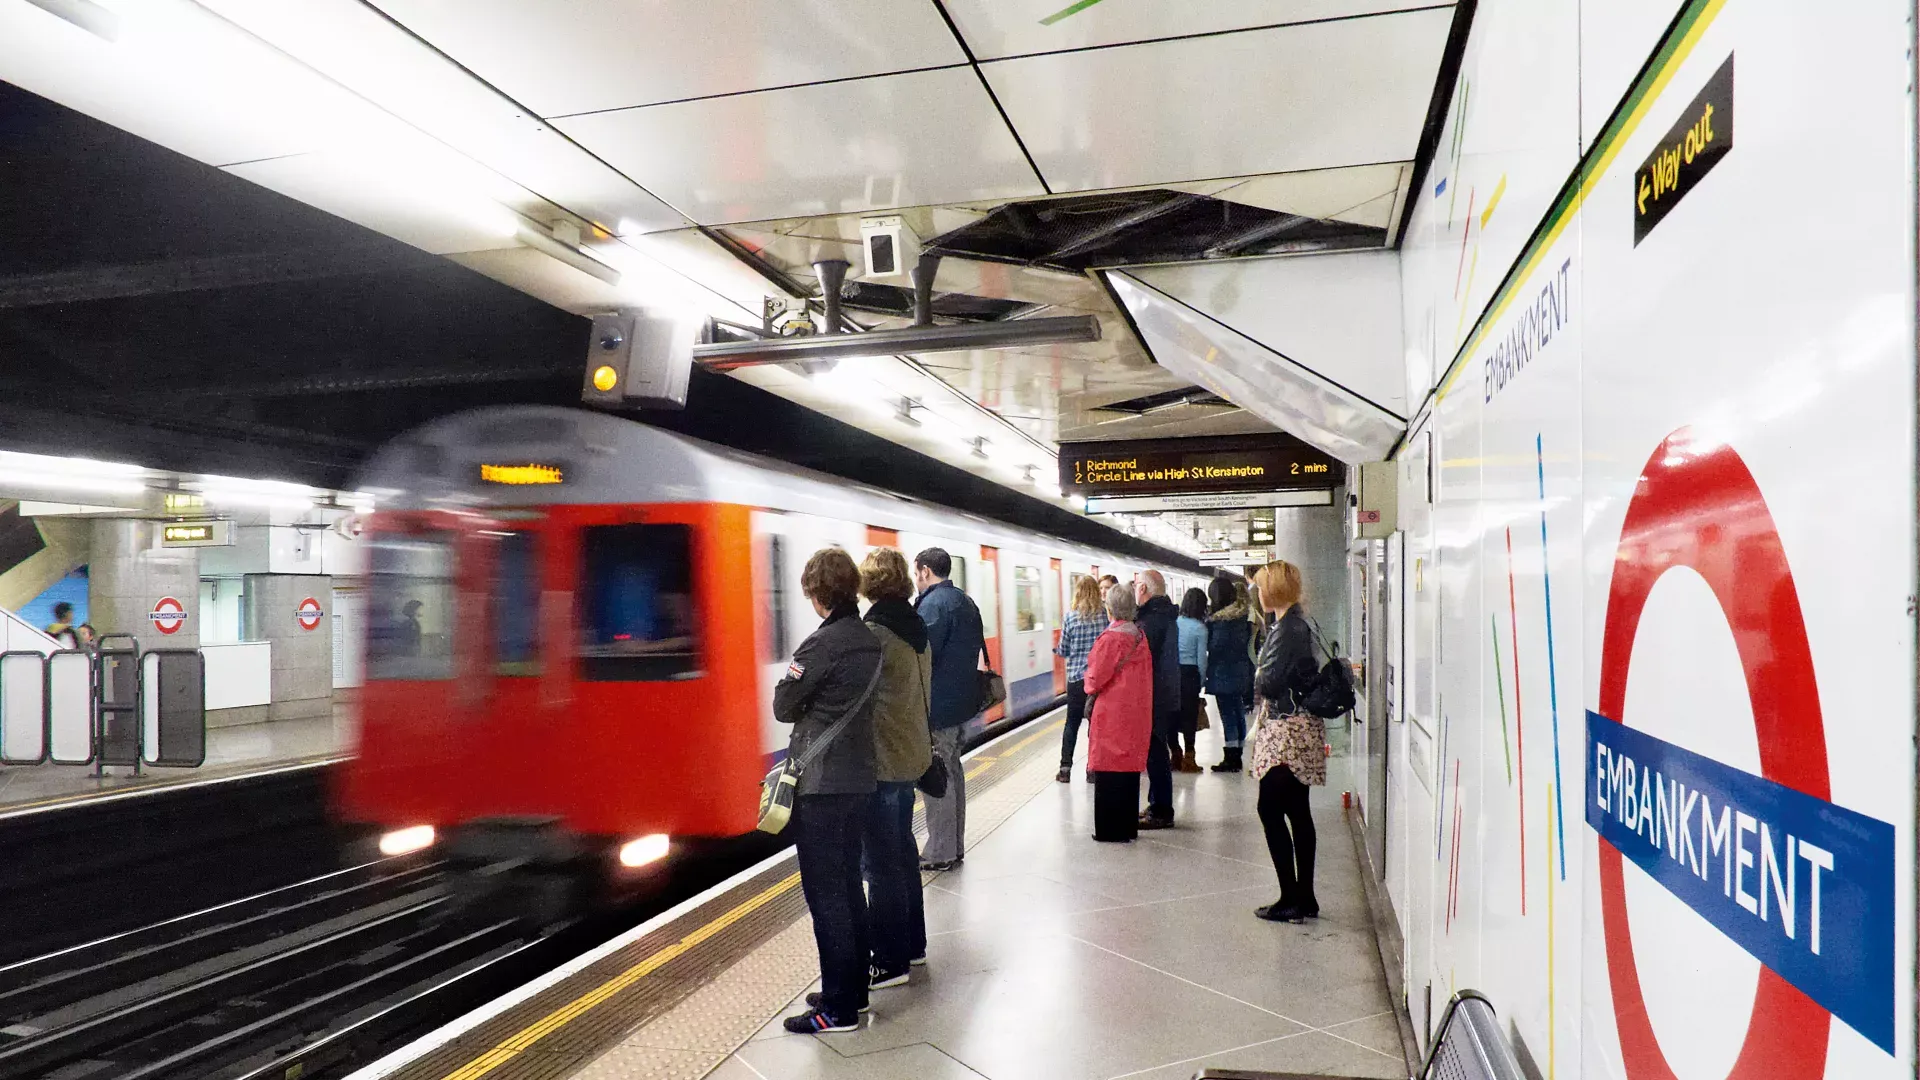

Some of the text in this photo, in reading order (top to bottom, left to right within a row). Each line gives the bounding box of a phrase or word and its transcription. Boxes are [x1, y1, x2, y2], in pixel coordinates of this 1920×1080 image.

[1652, 103, 1714, 200] Way out
[1485, 257, 1571, 405] EMBANKMENT
[1075, 459, 1137, 472] 1 Richmond
[1075, 463, 1327, 483] 2 Circle Line via High St Kensington 2 mins
[1597, 742, 1834, 956] EMBANKMENT
